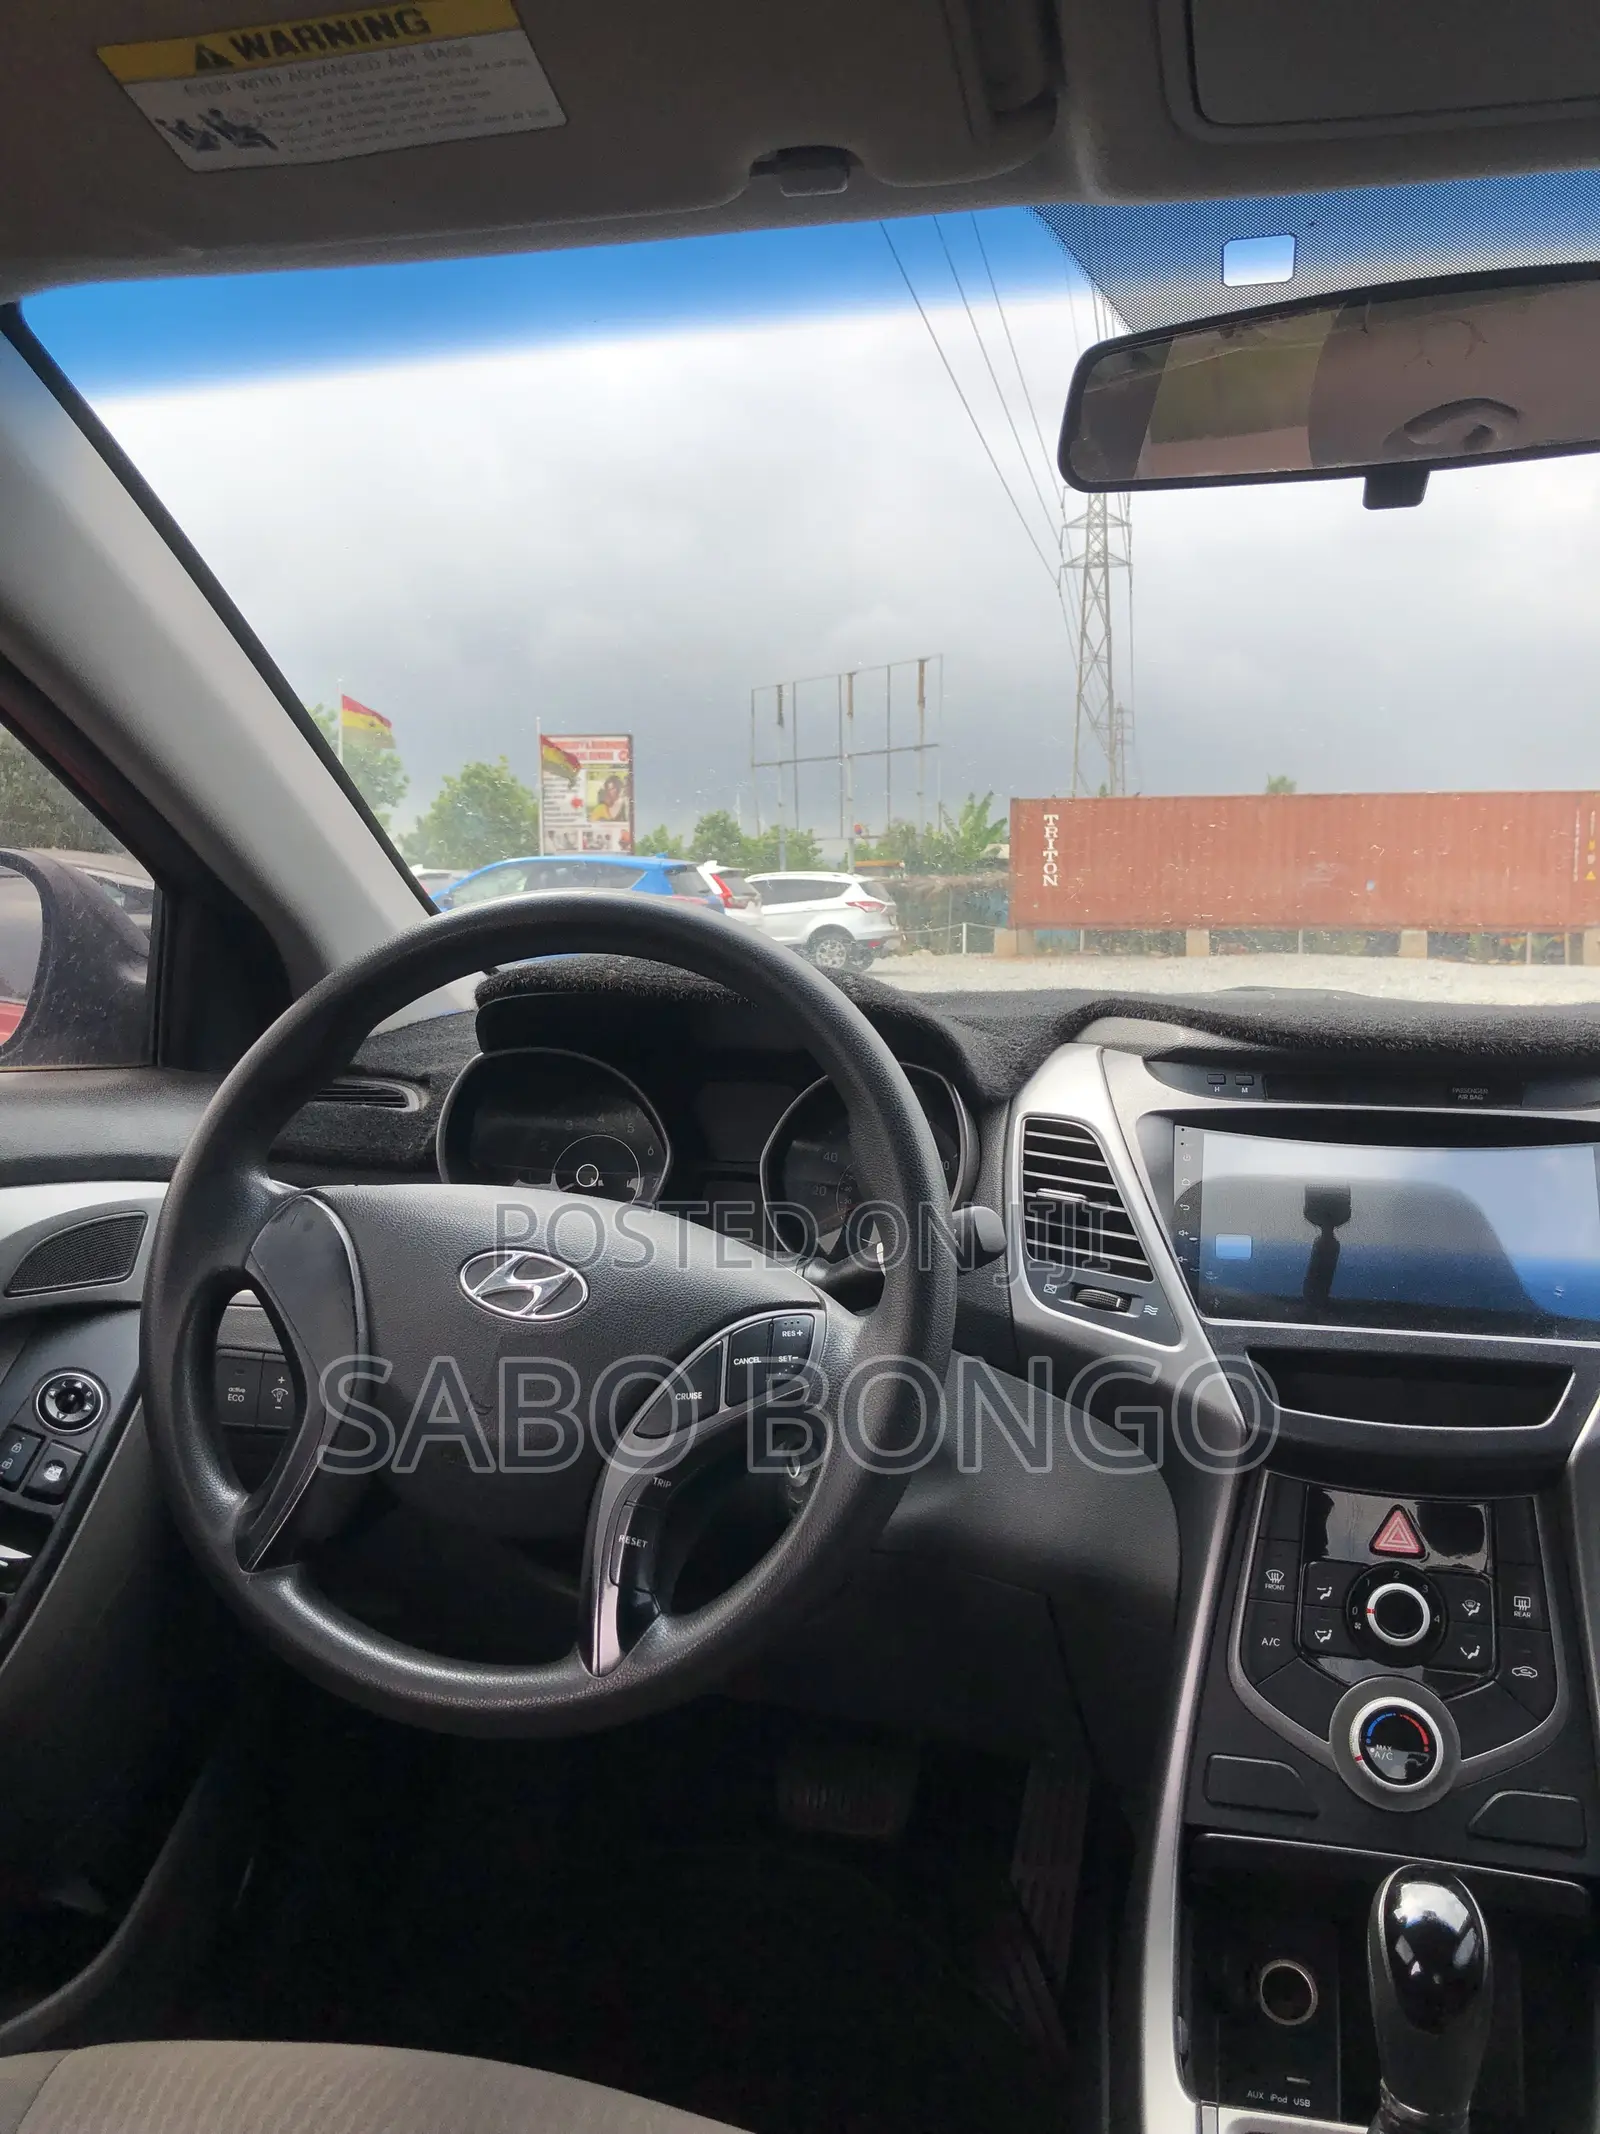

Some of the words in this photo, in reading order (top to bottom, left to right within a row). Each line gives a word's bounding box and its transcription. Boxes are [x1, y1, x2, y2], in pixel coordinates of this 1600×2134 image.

[229, 8, 432, 62] WARNING
[1042, 813, 1060, 887] TRITON
[1213, 1085, 1221, 1093] H
[1241, 1086, 1249, 1094] M
[823, 1151, 838, 1163] 40
[733, 1356, 762, 1366] CANCEL
[227, 1393, 245, 1403] ECO
[675, 1391, 703, 1401] CRUISE
[652, 1476, 673, 1489] TRIP
[618, 1534, 649, 1549] RESET
[1392, 1570, 1400, 1579] 2
[1264, 1582, 1286, 1592] FRONT
[1422, 1584, 1429, 1594] 3
[1352, 1606, 1359, 1616] 0
[1513, 1610, 1532, 1619] REAR
[1433, 1614, 1440, 1624] 4
[1261, 1637, 1281, 1647] A/C
[1376, 1744, 1392, 1752] MAX
[1374, 1751, 1394, 1761] A/C
[1246, 2090, 1265, 2100] AUX
[1269, 2093, 1288, 2104] iPod
[1293, 2097, 1311, 2108] USB
